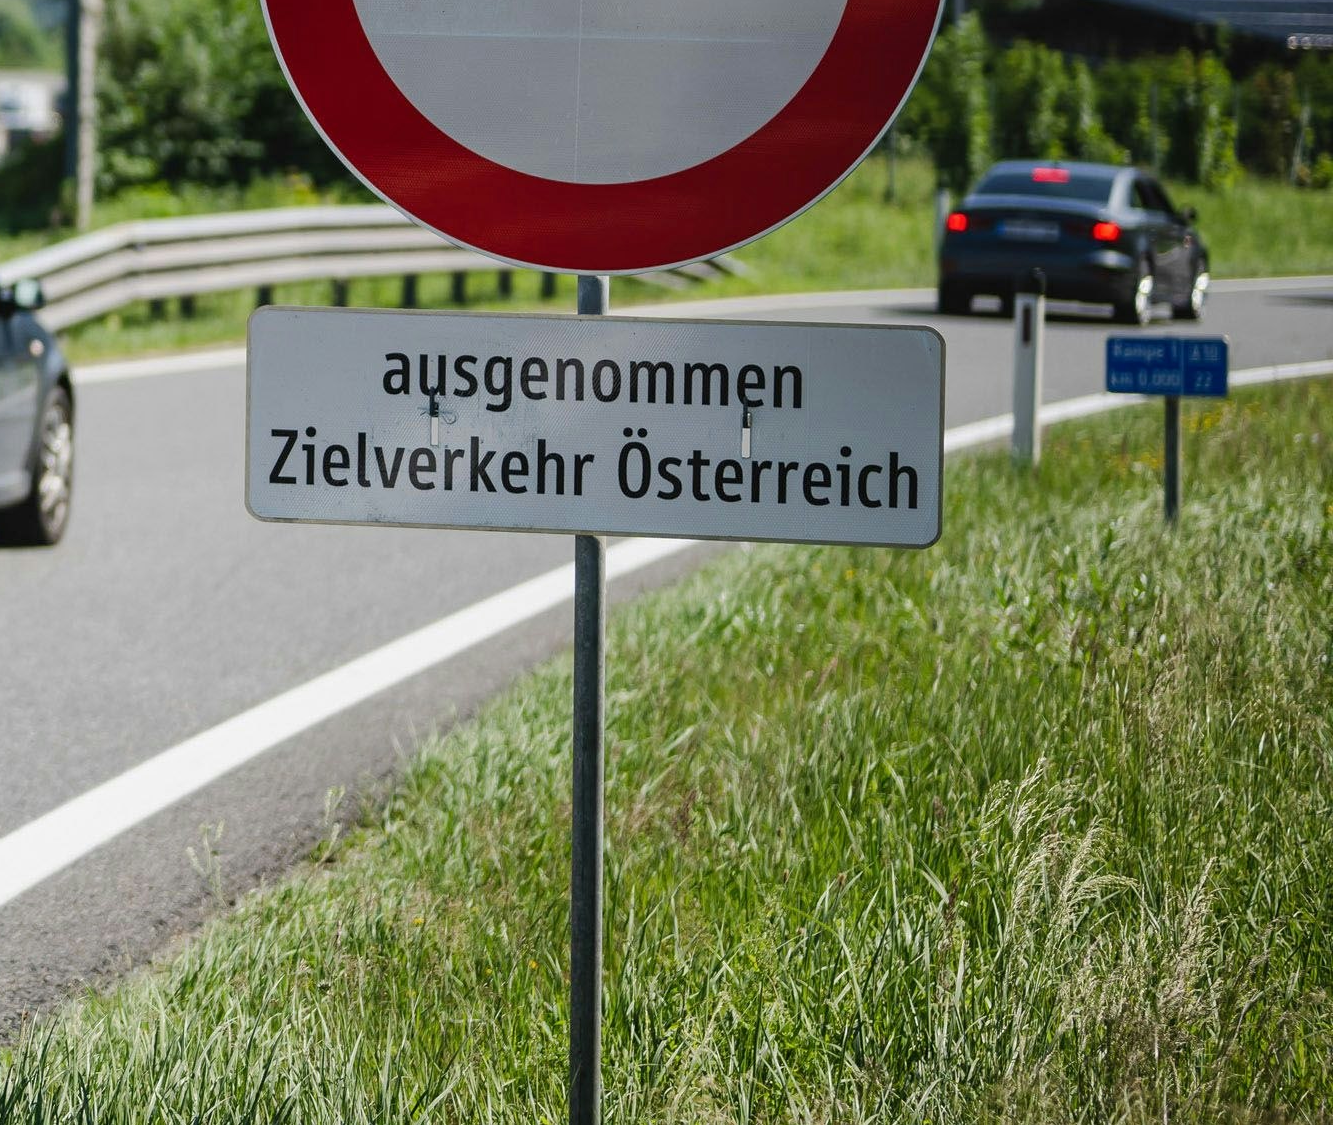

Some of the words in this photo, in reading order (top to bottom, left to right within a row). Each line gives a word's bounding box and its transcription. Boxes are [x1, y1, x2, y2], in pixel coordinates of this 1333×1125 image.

[382, 352, 803, 412] ausgenommen
[269, 426, 595, 498] Zielverkehr
[617, 427, 919, 510] Österreich
